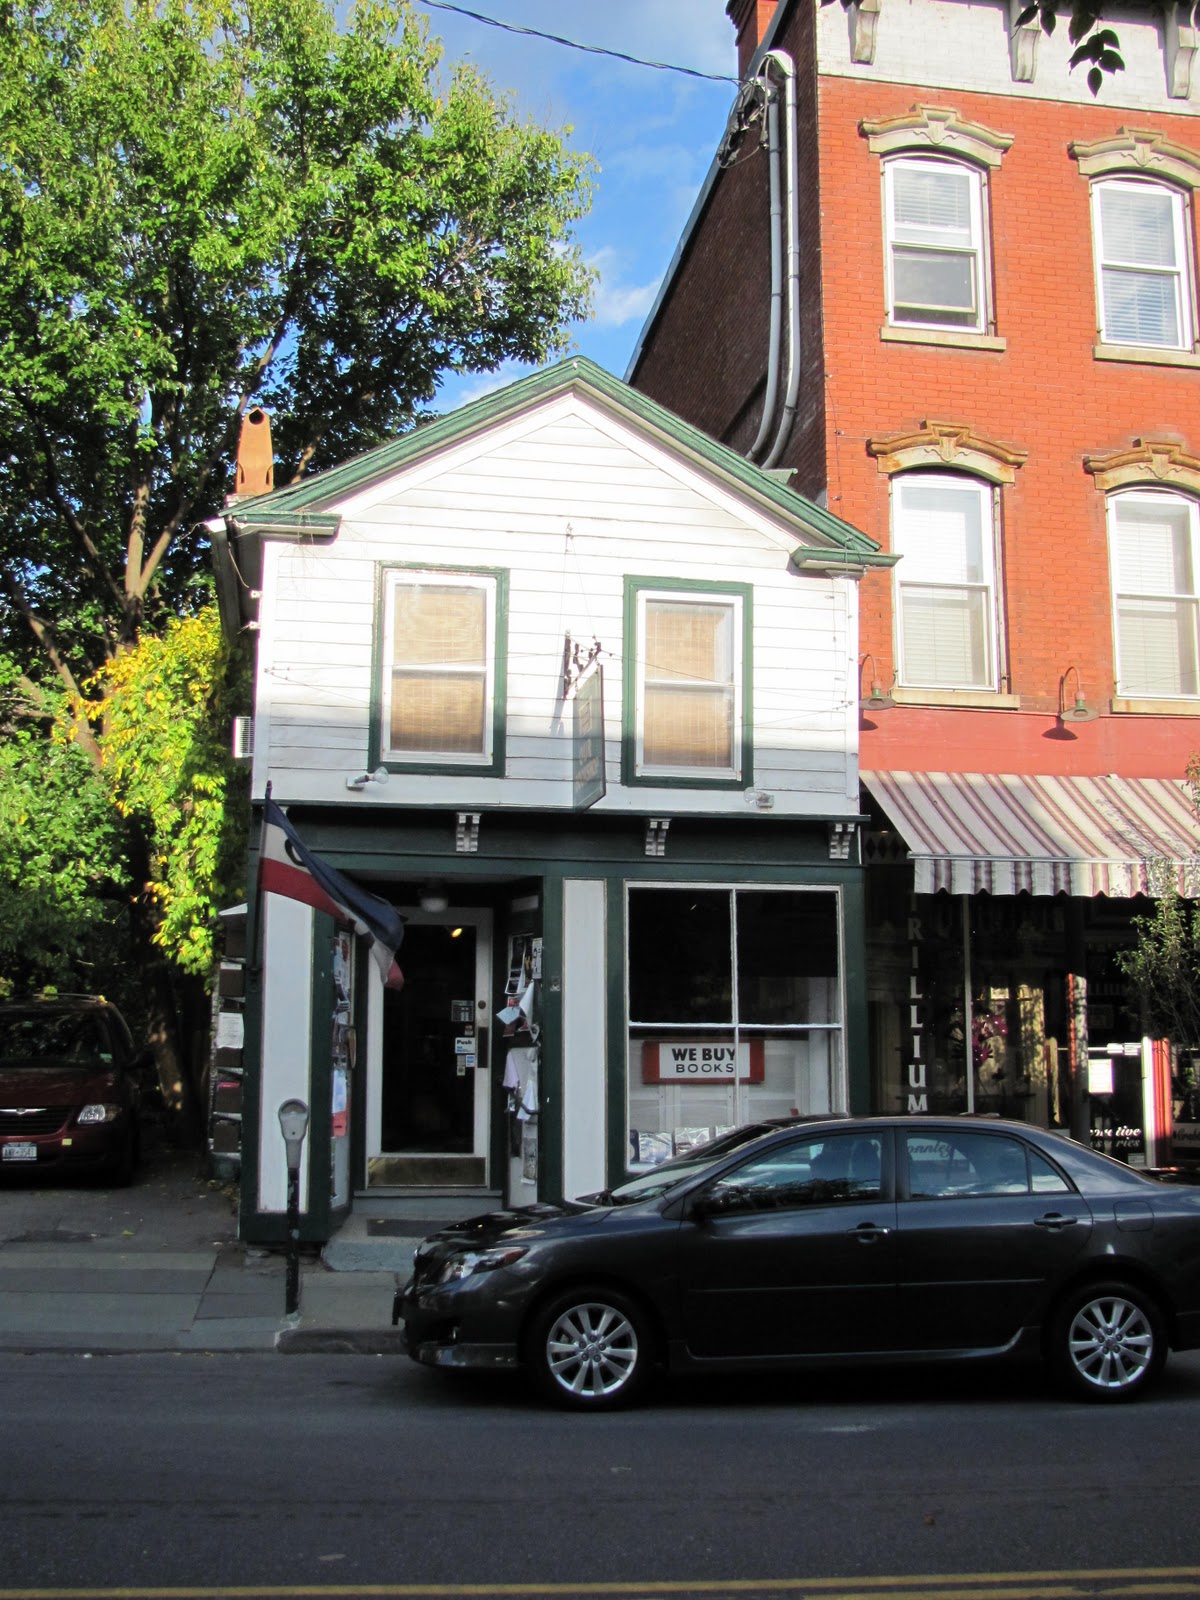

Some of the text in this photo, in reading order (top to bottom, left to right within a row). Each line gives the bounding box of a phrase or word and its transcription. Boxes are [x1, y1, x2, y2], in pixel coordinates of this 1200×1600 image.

[672, 1048, 735, 1061] WE BUY
[676, 1063, 734, 1073] BOOKS
